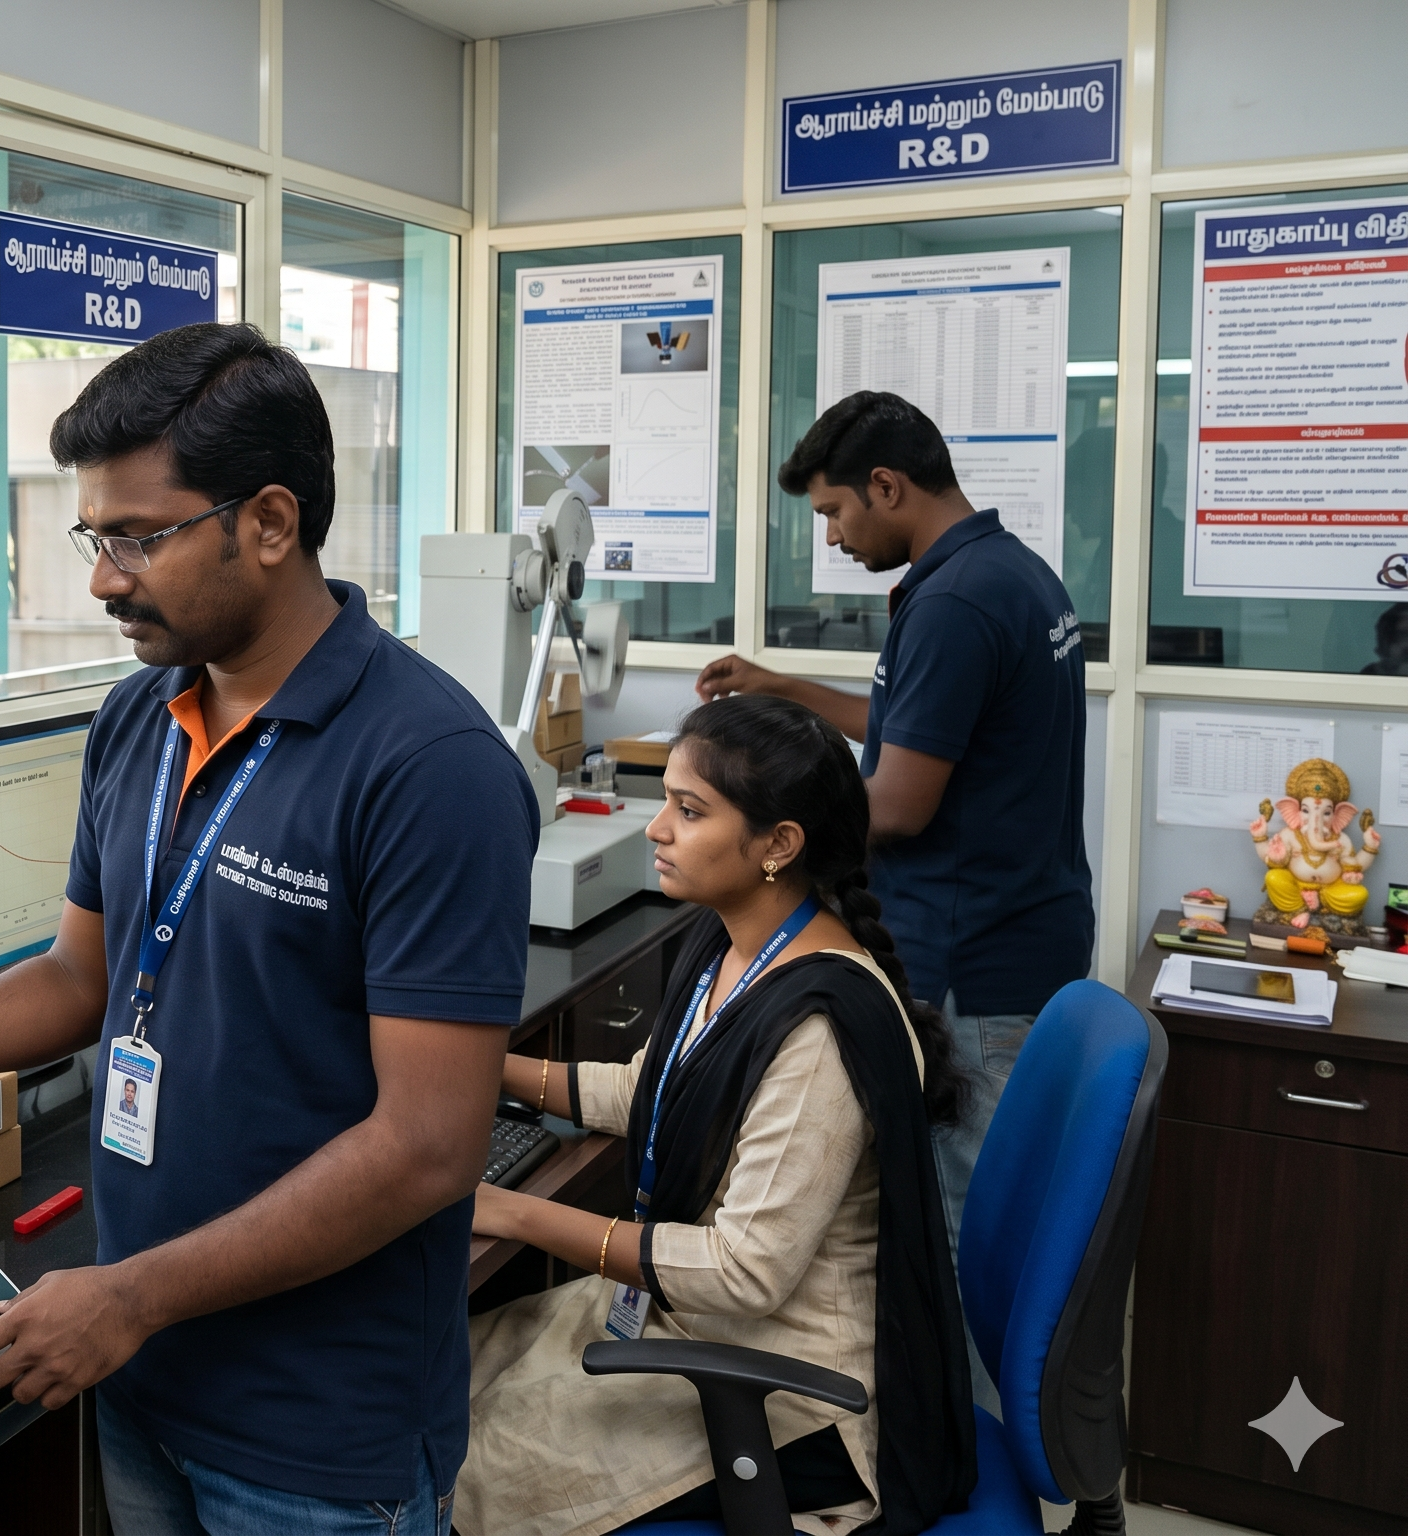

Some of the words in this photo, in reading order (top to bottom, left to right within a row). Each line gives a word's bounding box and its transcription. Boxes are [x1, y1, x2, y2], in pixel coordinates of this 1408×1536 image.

[795, 98, 903, 141] ஆராய்ச்சி
[909, 89, 991, 131] மற்றும்
[996, 80, 1105, 116] மேம்பாடு
[898, 133, 990, 170] R&D
[1216, 216, 1349, 253] பாதுகாப்பு
[5, 237, 87, 275] ஆராய்ச்சி
[91, 247, 144, 291] மற்றும்
[148, 255, 211, 300] மேம்பாடு
[85, 292, 142, 330] R&D
